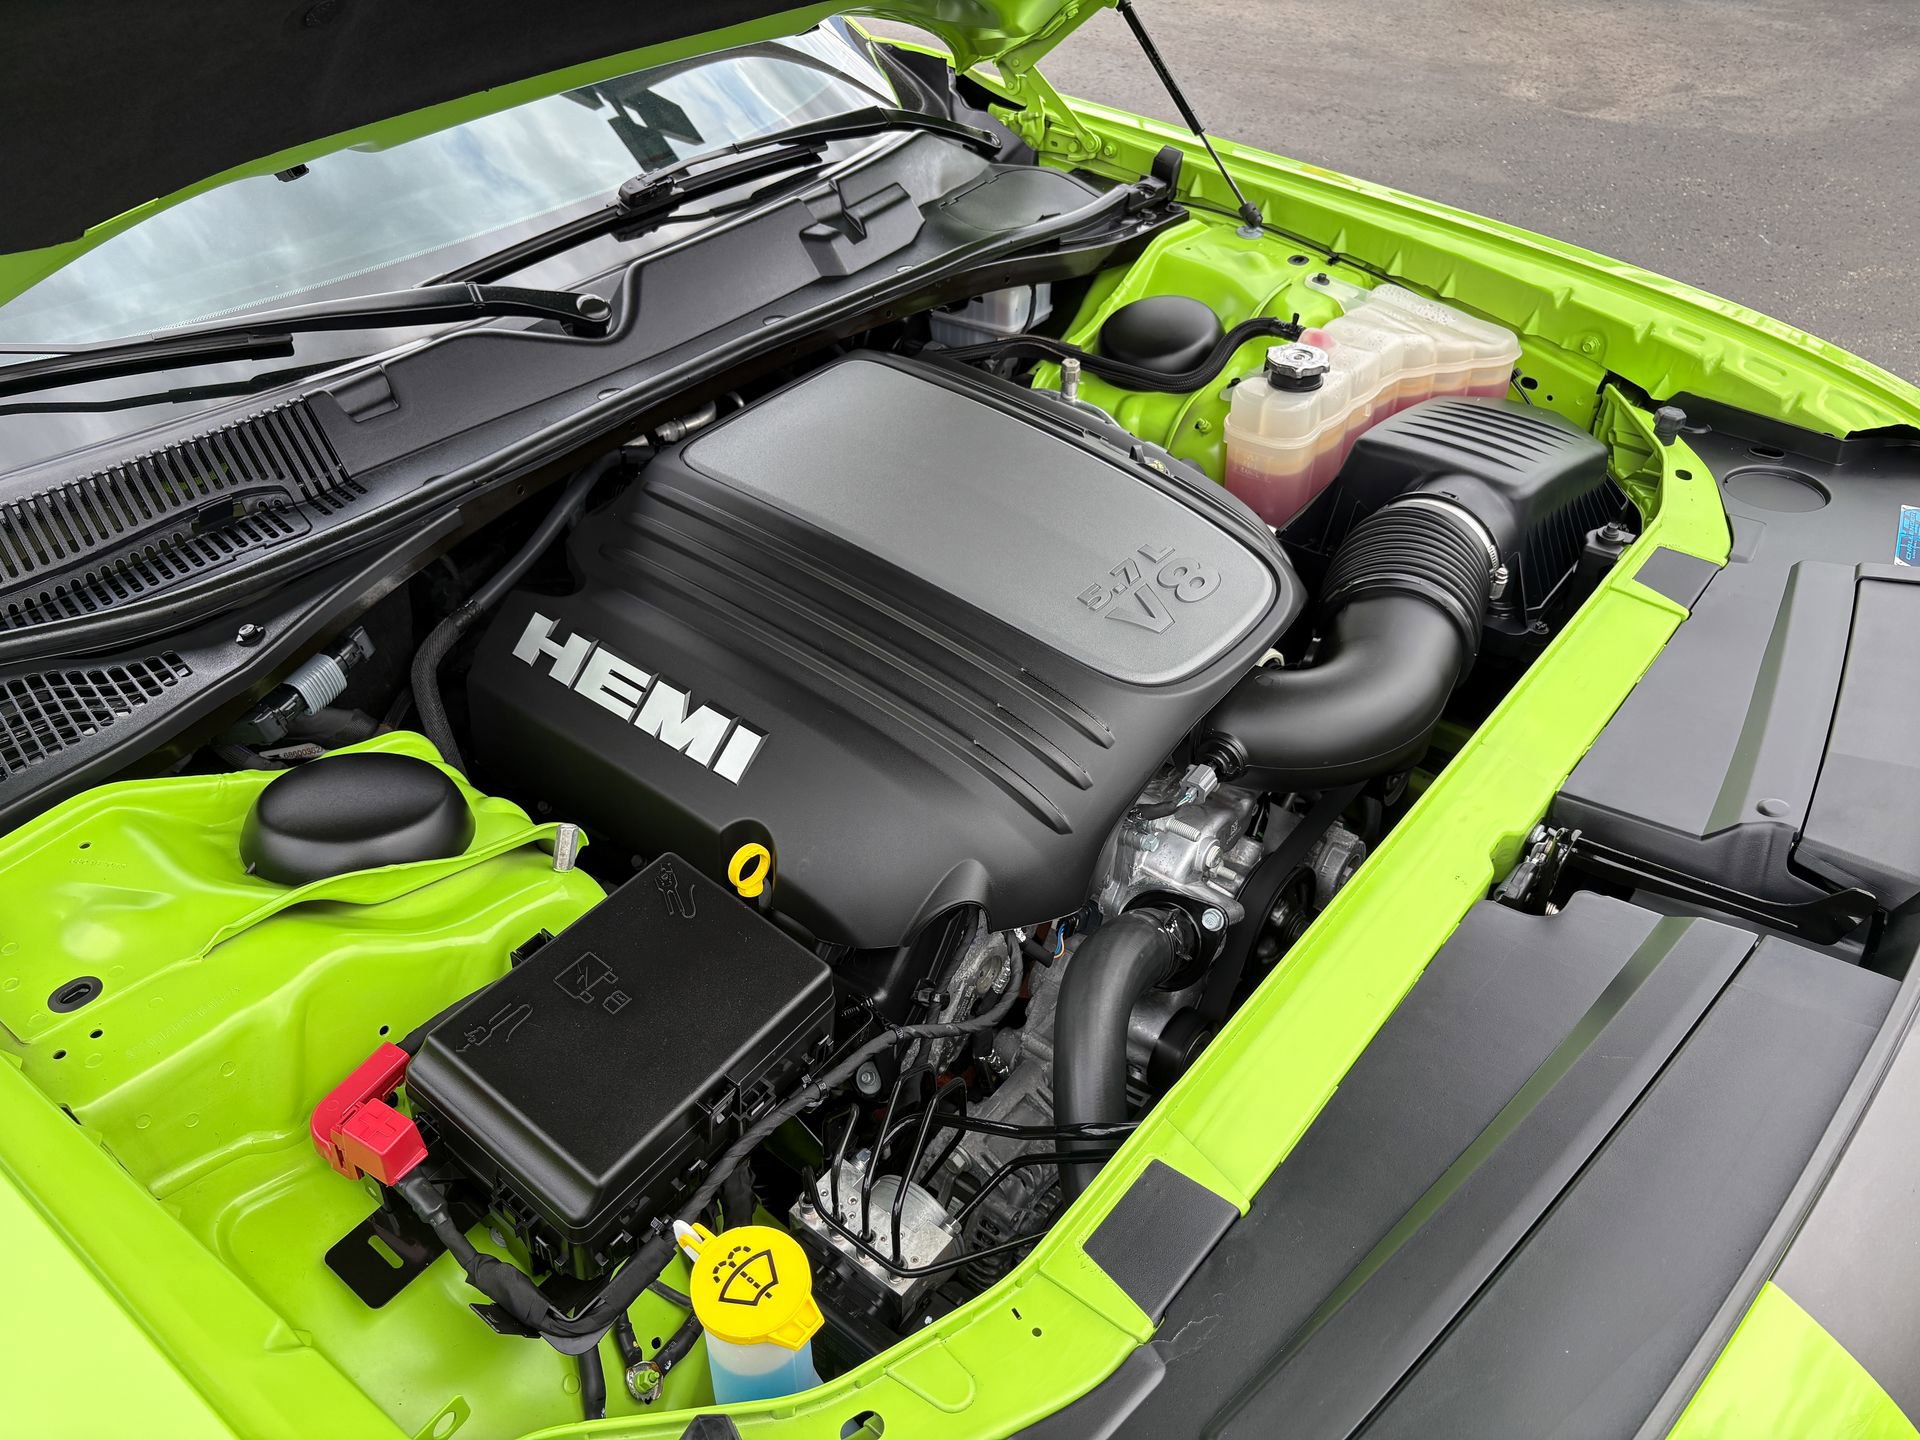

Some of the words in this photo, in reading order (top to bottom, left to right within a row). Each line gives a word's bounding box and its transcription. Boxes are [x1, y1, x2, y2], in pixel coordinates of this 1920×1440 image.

[1075, 557, 1142, 611] 5.7
[1104, 557, 1222, 635] V8
[512, 611, 770, 788] HEMI
